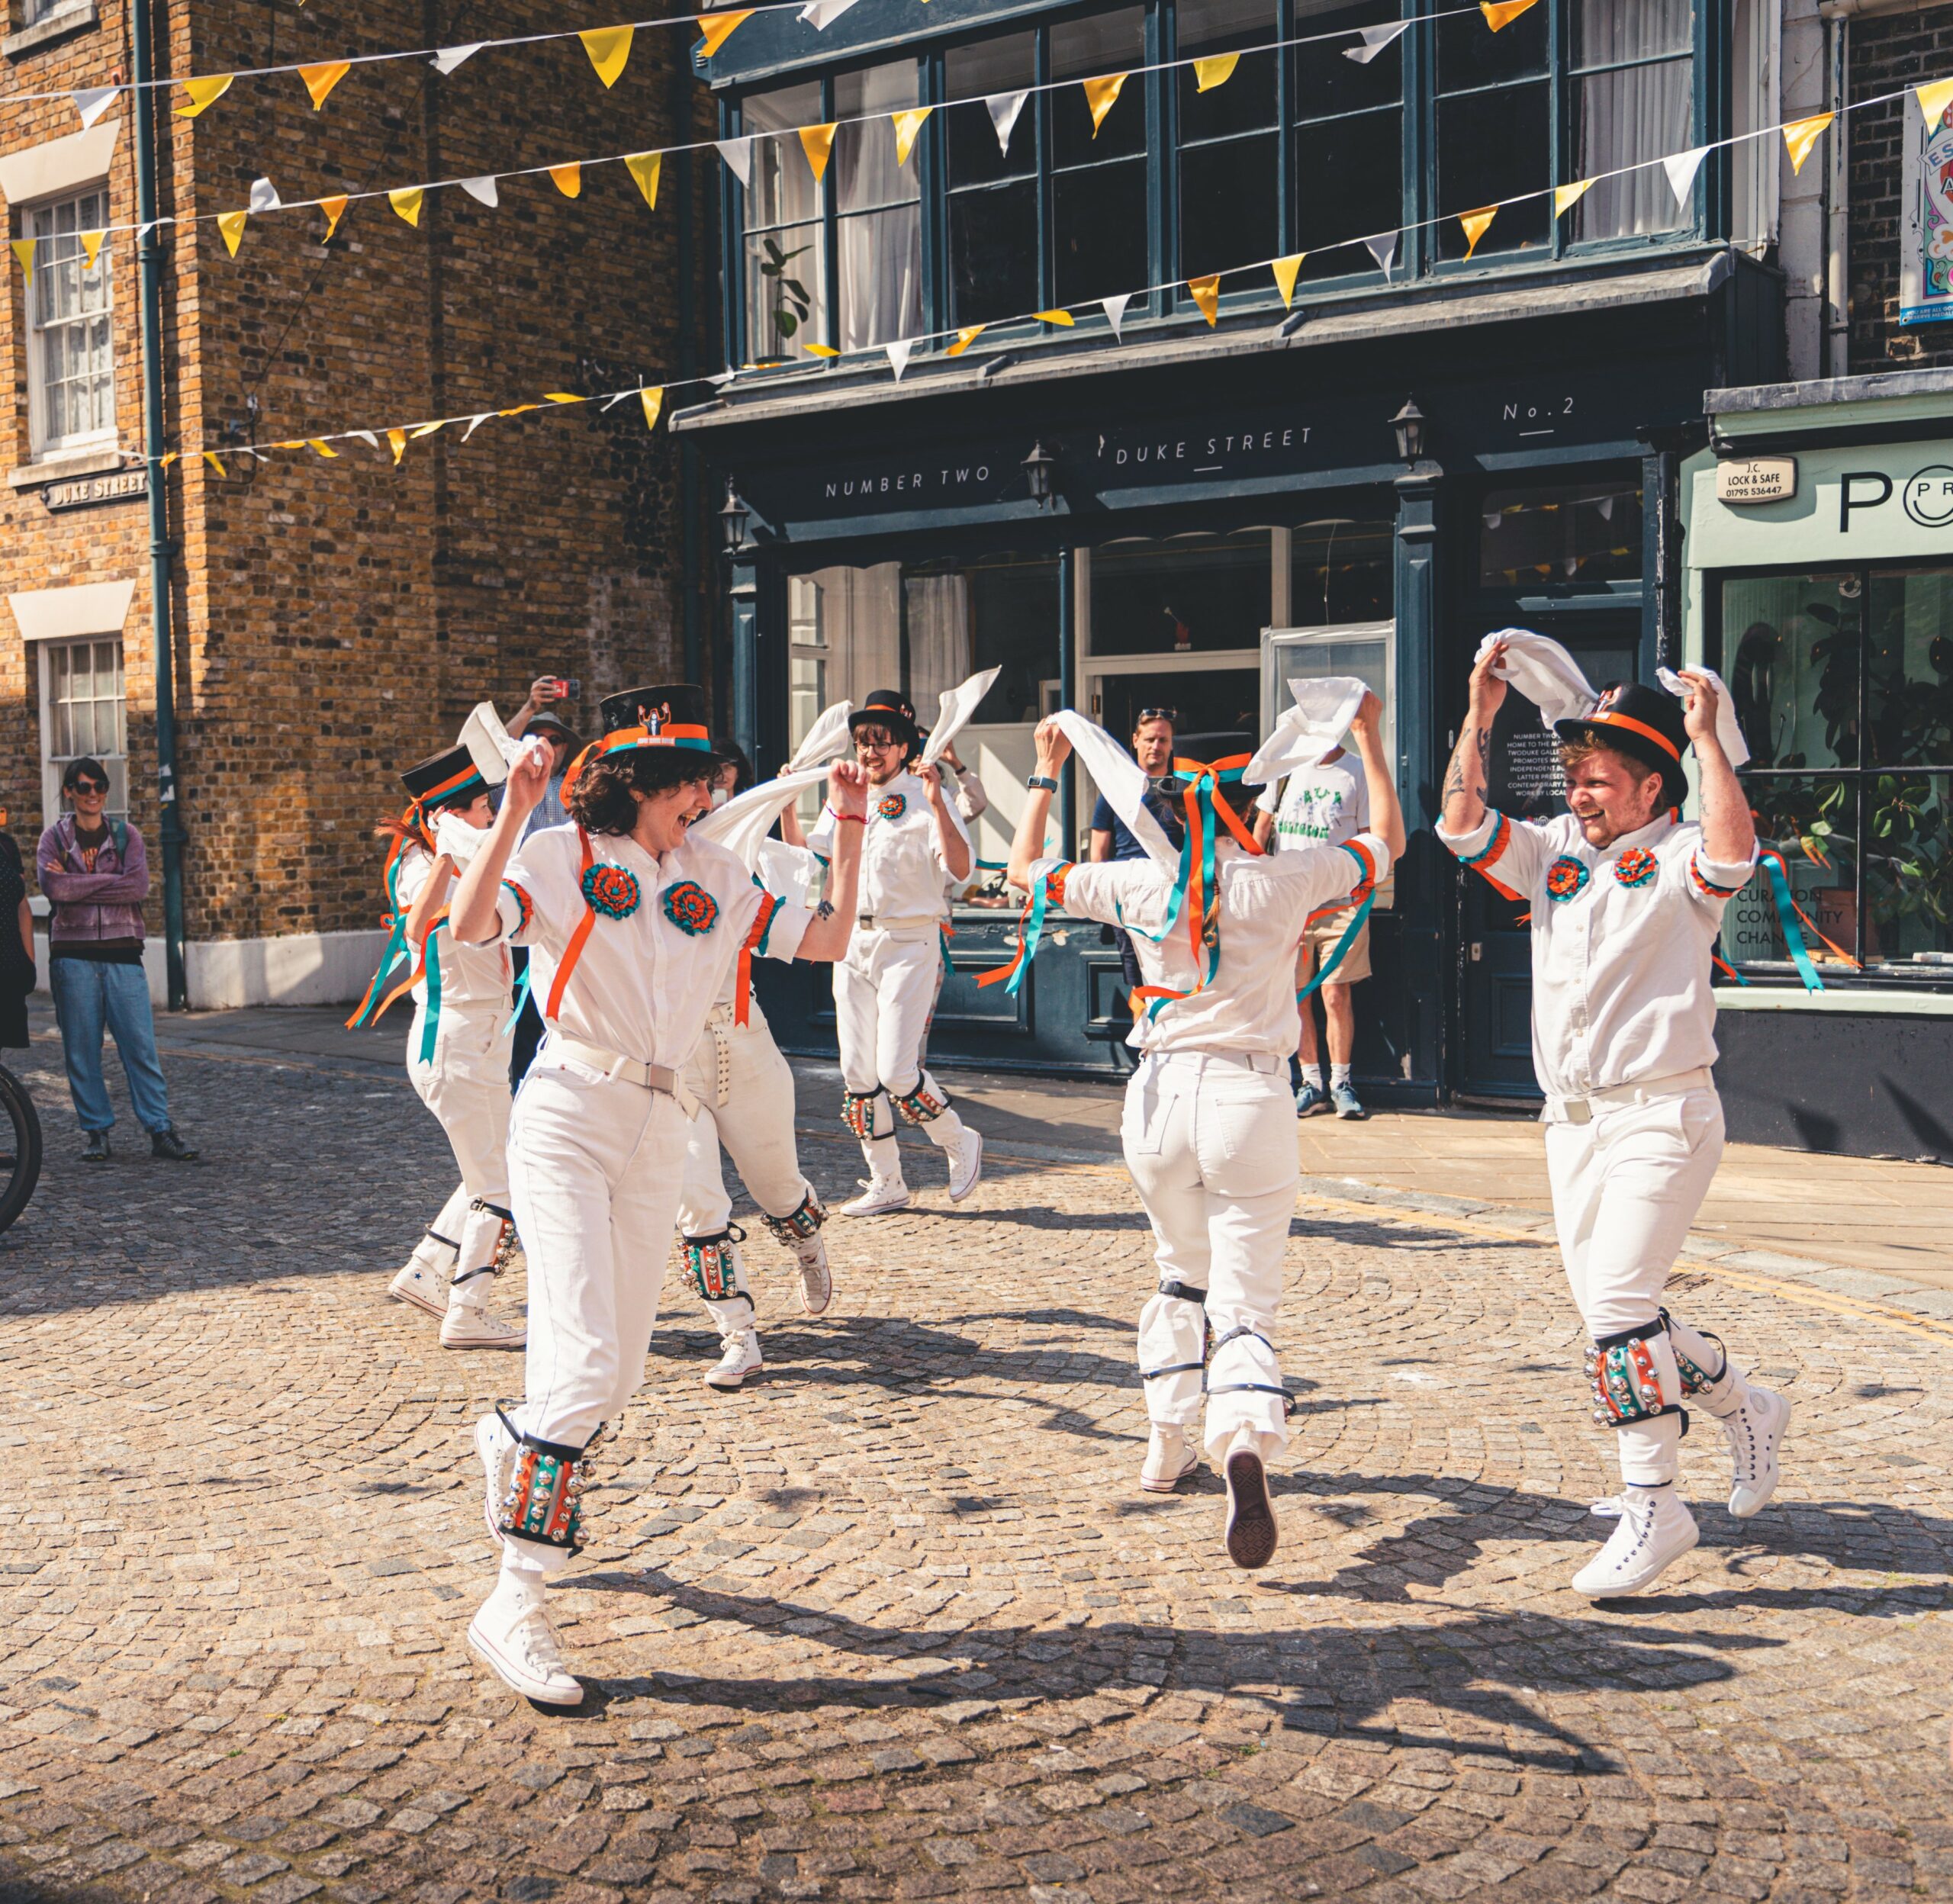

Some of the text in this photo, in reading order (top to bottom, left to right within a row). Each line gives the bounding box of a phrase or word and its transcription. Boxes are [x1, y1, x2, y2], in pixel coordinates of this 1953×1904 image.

[1116, 428, 1311, 464] DUKE STREET
[1747, 463, 1760, 473] J.C.
[825, 466, 989, 497] NUMBER TWO
[1728, 473, 1780, 486] LOCK & SAFE
[54, 471, 147, 505] DUKE STREET
[1726, 486, 1782, 497] 01795 536447
[1737, 910, 1844, 924] COMUNITY
[1737, 931, 1808, 944] CHANE
